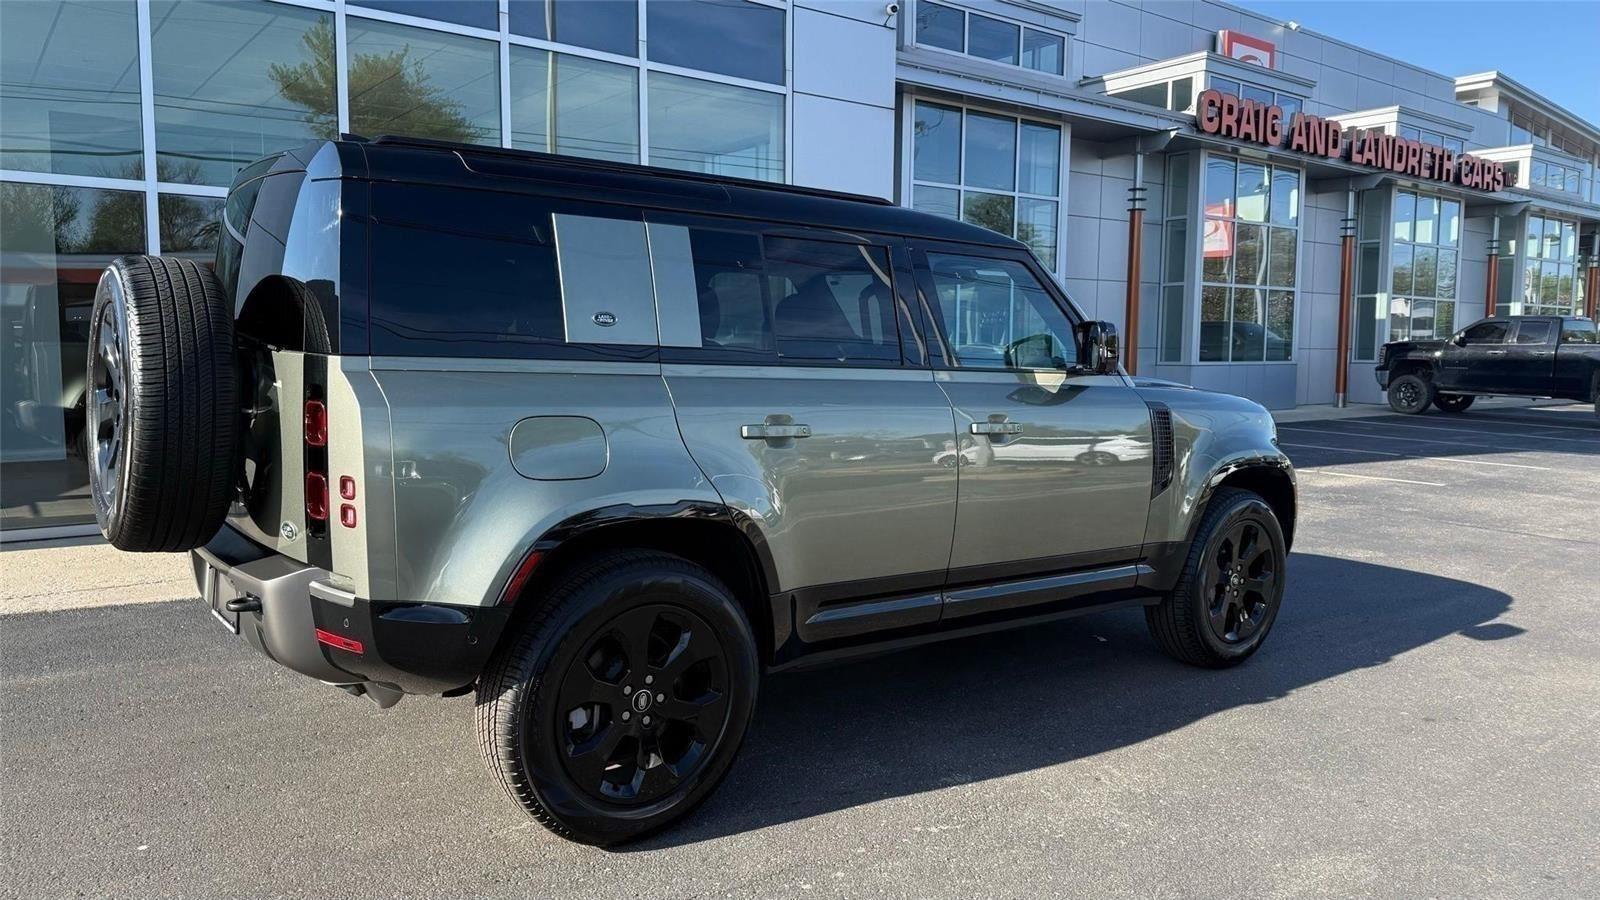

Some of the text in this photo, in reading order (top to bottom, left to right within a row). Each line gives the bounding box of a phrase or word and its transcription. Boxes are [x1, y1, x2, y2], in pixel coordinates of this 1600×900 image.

[1199, 89, 1283, 146] CRAIG
[1290, 112, 1343, 158] AND
[1351, 126, 1455, 183] LANDRETH
[1459, 154, 1504, 192] CARS
